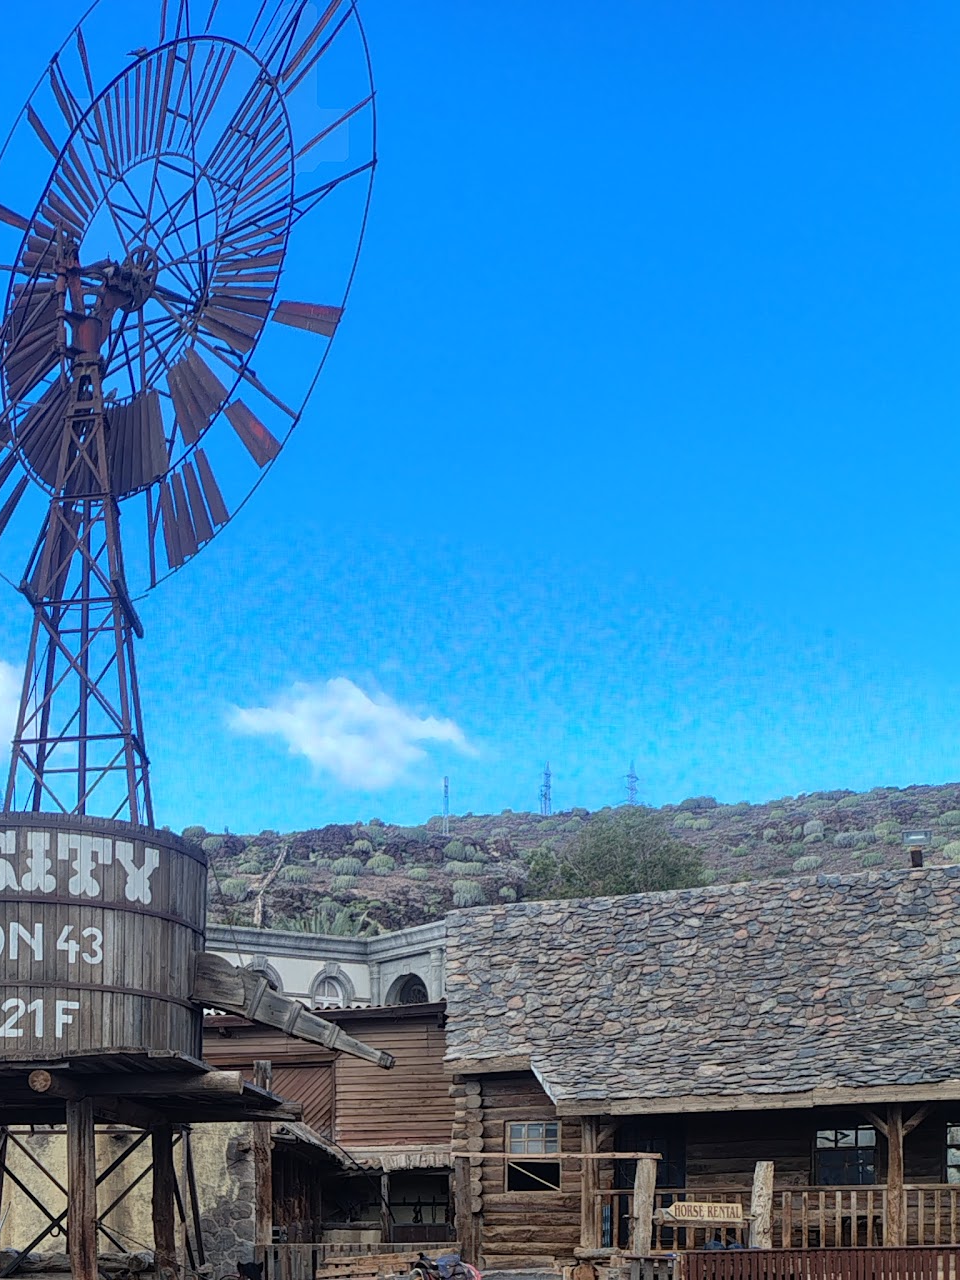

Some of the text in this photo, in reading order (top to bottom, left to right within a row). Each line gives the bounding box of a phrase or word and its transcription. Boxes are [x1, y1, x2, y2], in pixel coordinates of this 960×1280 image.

[56, 925, 104, 965] 43
[674, 1204, 741, 1219] HORSE RENTAL
